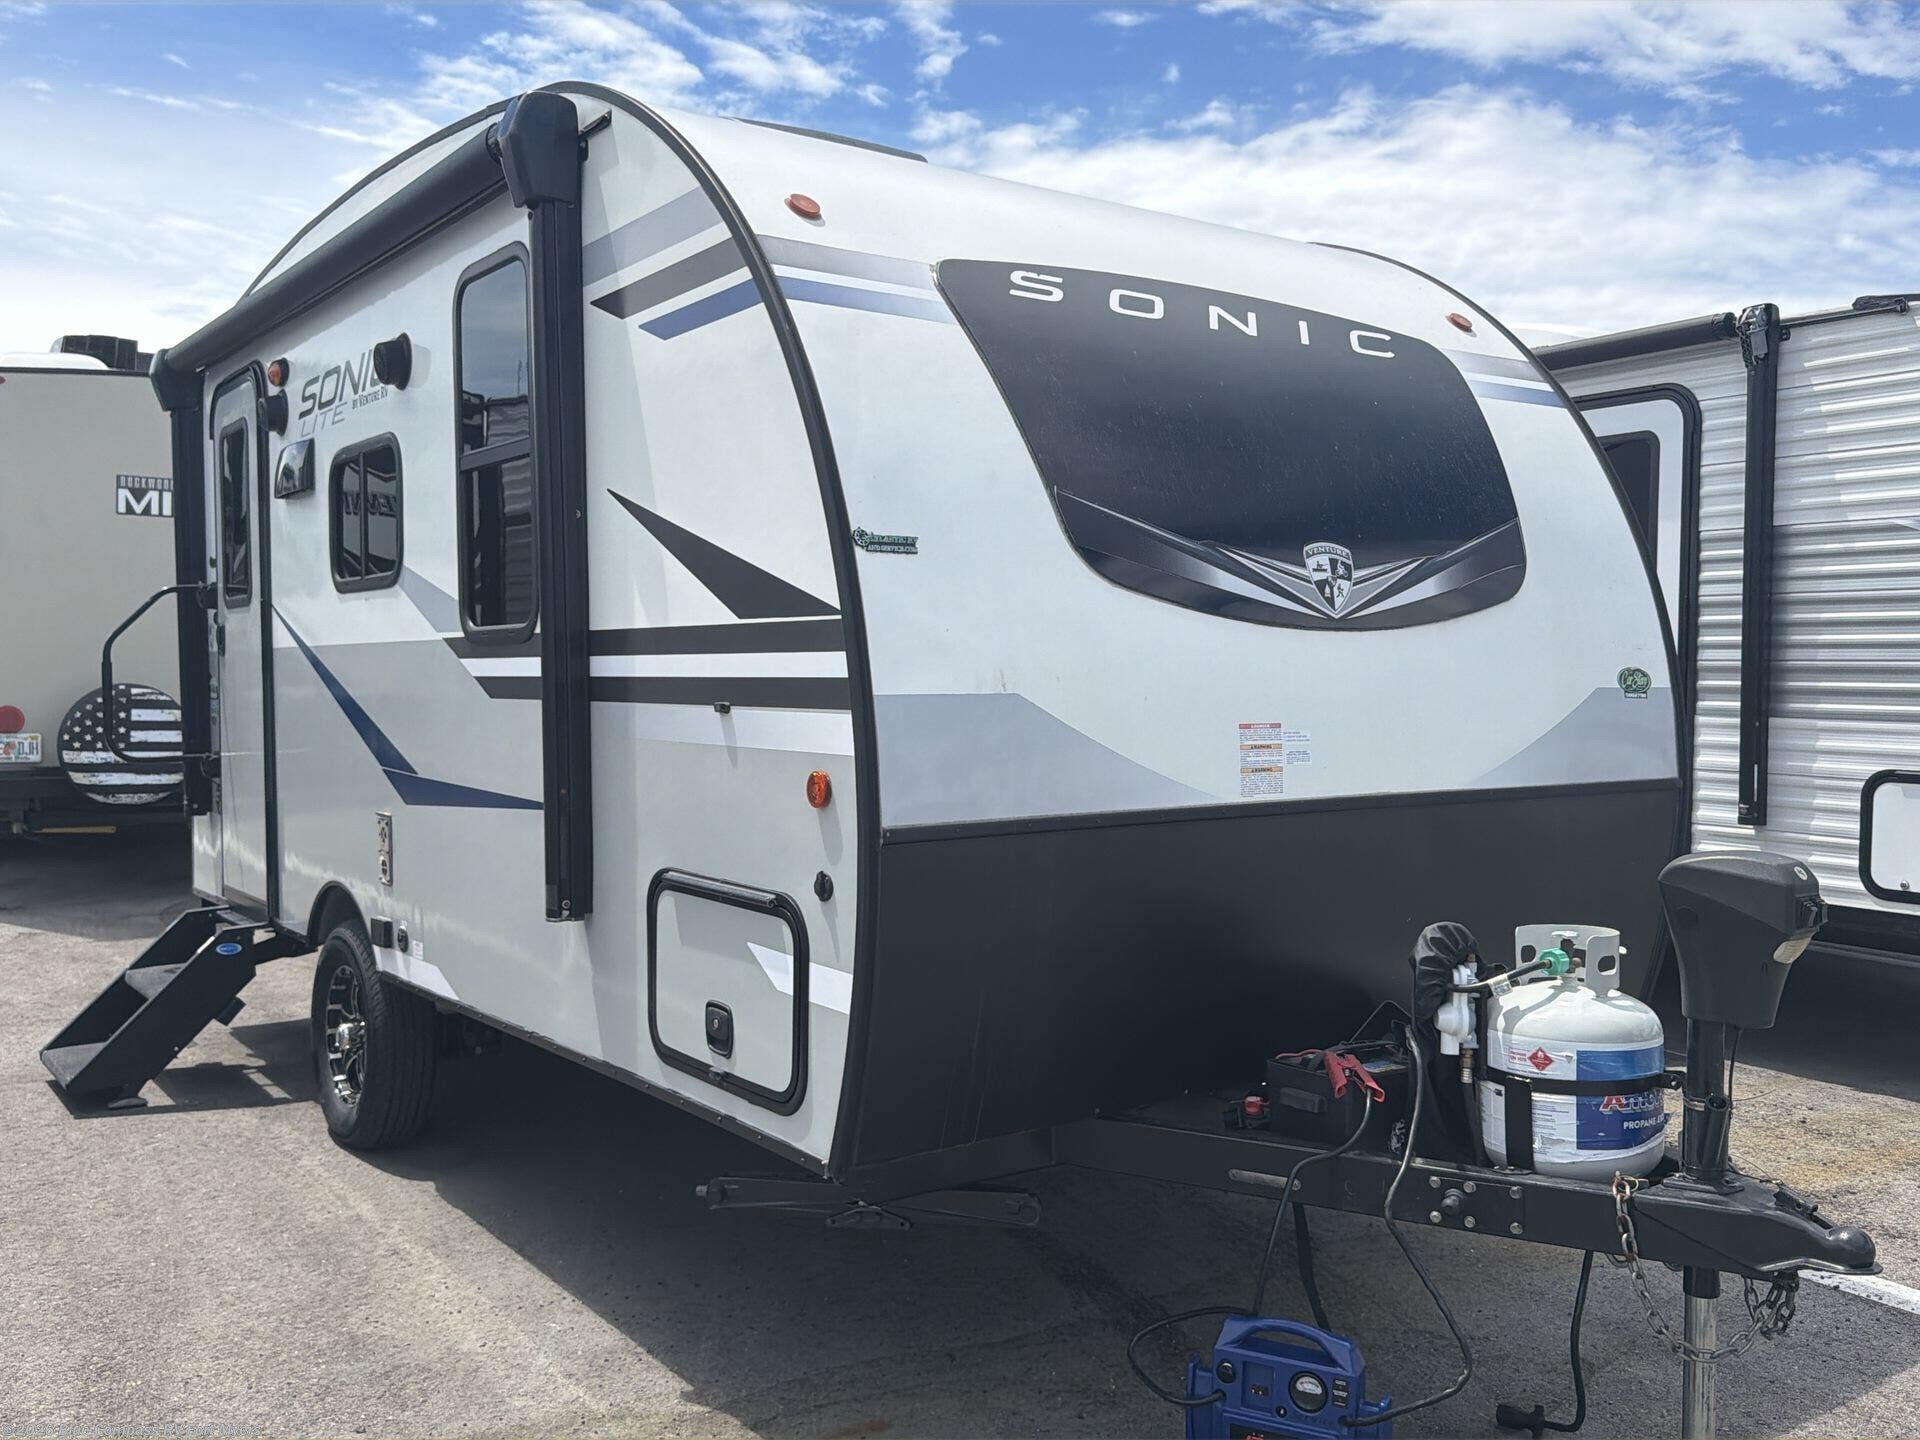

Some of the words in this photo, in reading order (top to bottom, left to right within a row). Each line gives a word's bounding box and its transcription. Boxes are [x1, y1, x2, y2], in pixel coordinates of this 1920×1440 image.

[1009, 270, 1396, 358] SONIC
[301, 401, 348, 438] LITE
[1307, 546, 1349, 559] VENTURE
[1623, 1117, 1656, 1130] PROPANE
